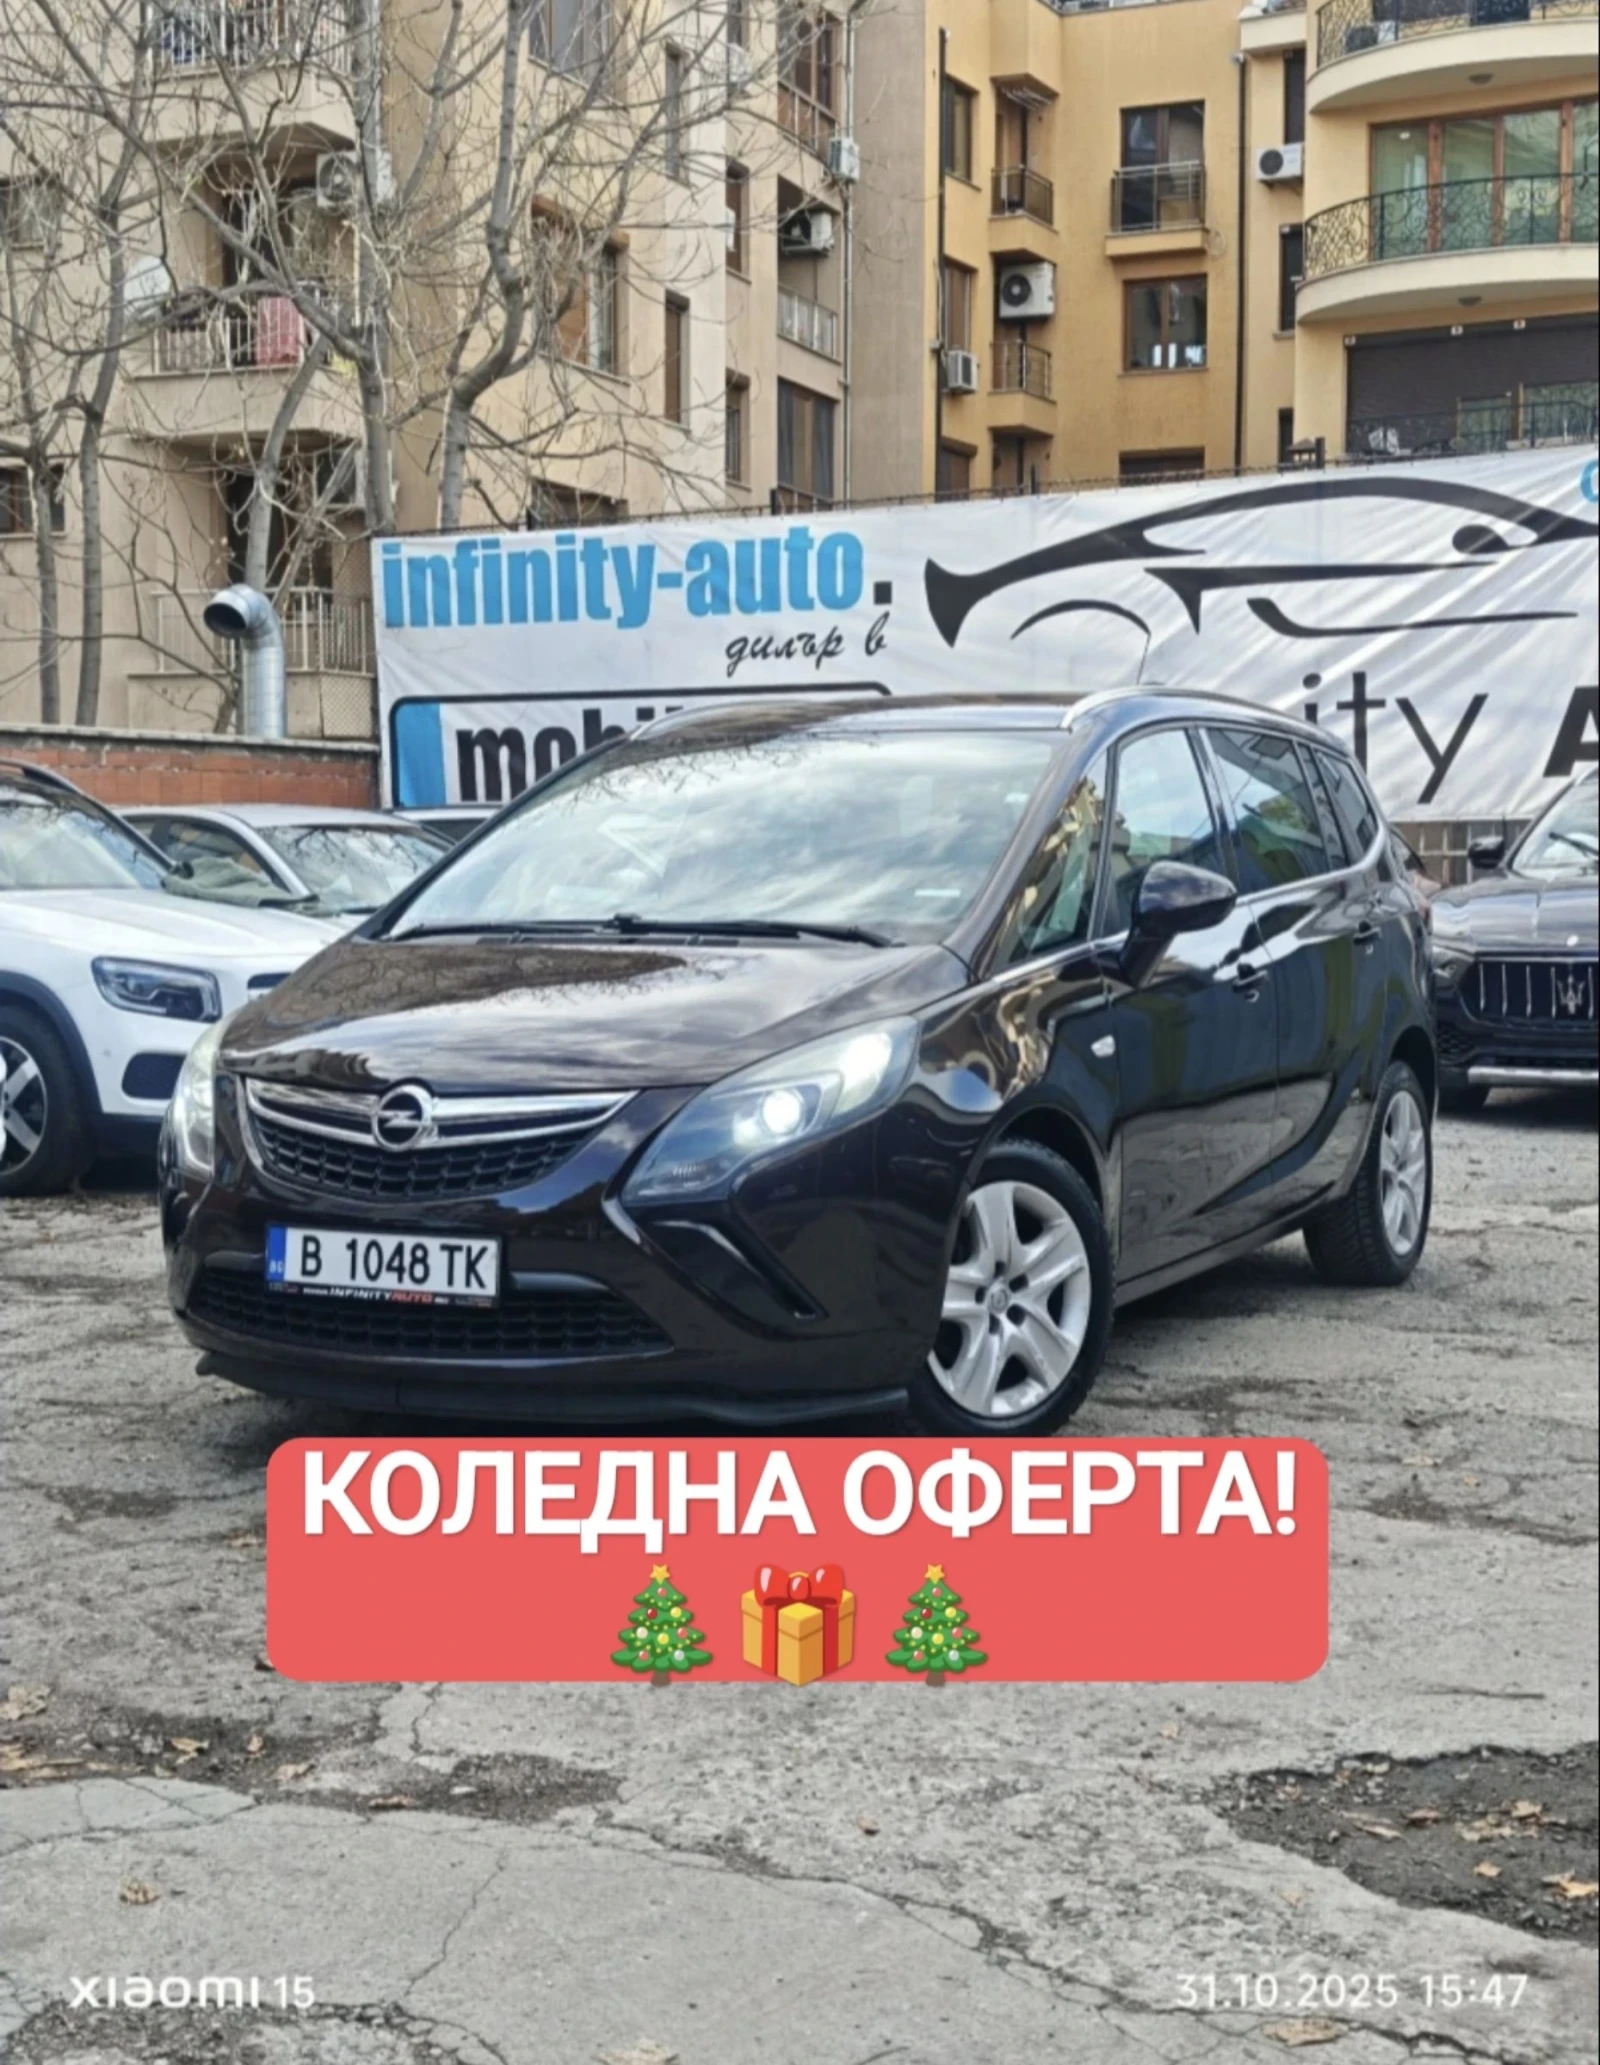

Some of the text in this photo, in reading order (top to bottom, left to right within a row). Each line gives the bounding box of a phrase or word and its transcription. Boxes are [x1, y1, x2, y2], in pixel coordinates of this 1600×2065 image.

[725, 625, 845, 678] дилър
[301, 1234, 489, 1289] B 1048 TK
